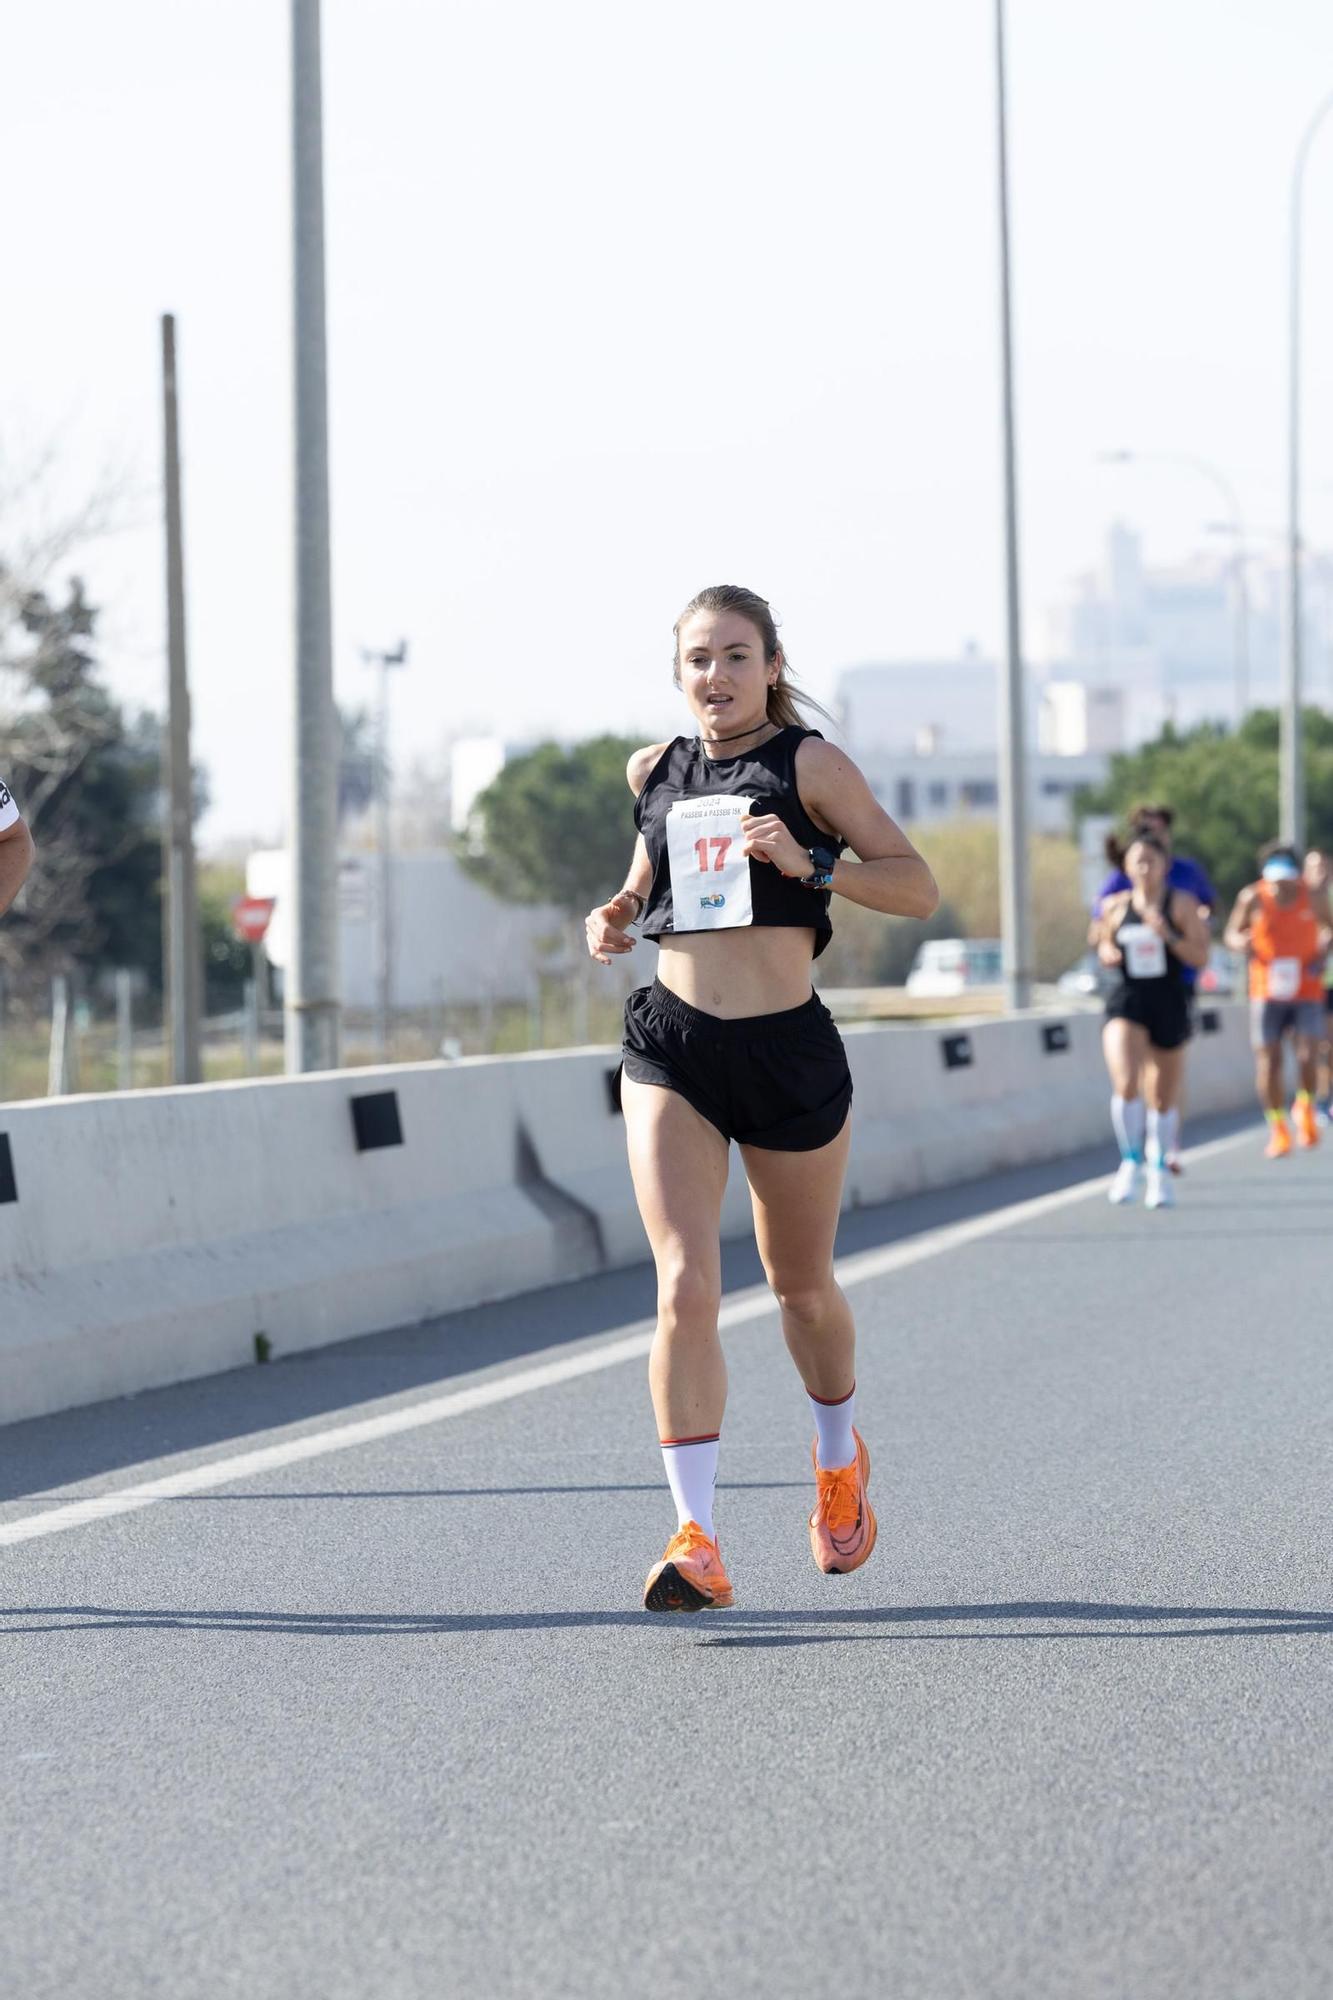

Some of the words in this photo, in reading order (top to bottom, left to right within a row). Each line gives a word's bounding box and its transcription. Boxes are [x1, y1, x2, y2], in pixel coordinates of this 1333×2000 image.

[697, 798, 720, 807] 2024
[681, 810, 703, 819] PASSEIG
[709, 808, 731, 817] PASSEIG
[695, 837, 732, 872] 17
